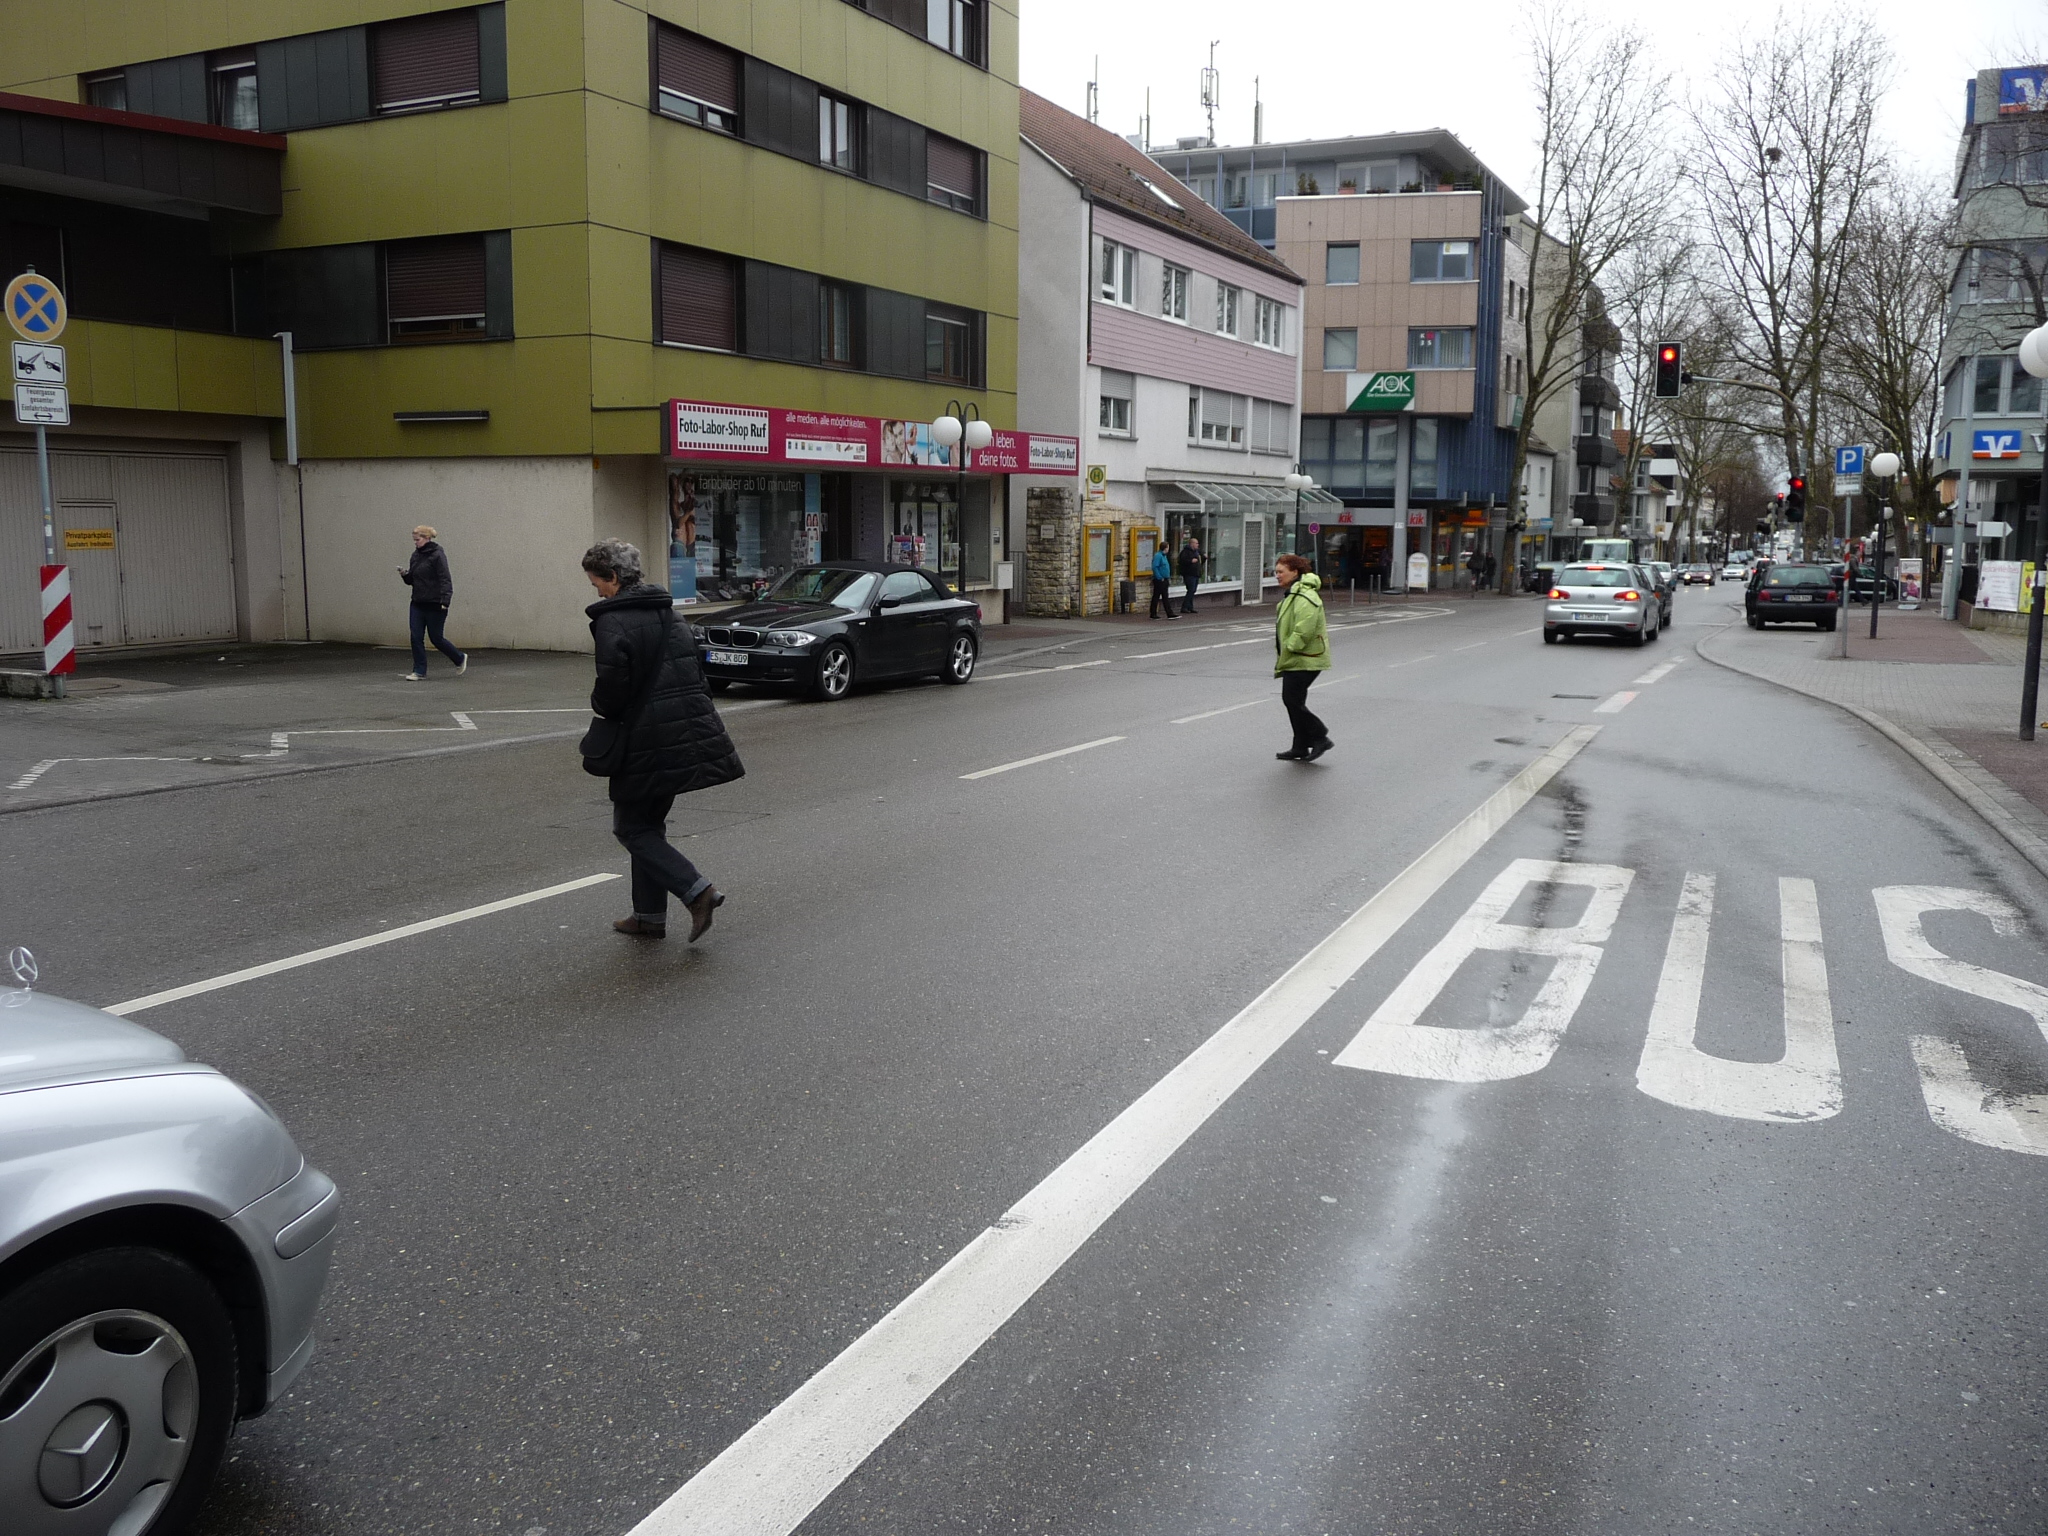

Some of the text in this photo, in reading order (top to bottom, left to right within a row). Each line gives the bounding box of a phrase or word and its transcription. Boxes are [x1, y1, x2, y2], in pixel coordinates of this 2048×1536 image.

[1370, 375, 1411, 392] AOK
[21, 403, 64, 413] Einfahrtsbereich
[785, 411, 796, 423] alle
[796, 413, 819, 425] medien.
[820, 414, 829, 426] alle
[679, 417, 748, 441] Foto-Labor-Shop
[750, 423, 766, 438] Ruf
[995, 432, 1016, 449] leben.
[979, 451, 1018, 468] deine fotos.
[1030, 445, 1075, 461] Foto-Labor-Shop Ruf
[1841, 450, 1857, 471] P
[744, 475, 755, 491] ab
[756, 476, 766, 491] 10
[767, 479, 804, 492] minuten.
[65, 531, 113, 540] Privatparkplatz
[1332, 858, 2048, 1157] BUS
